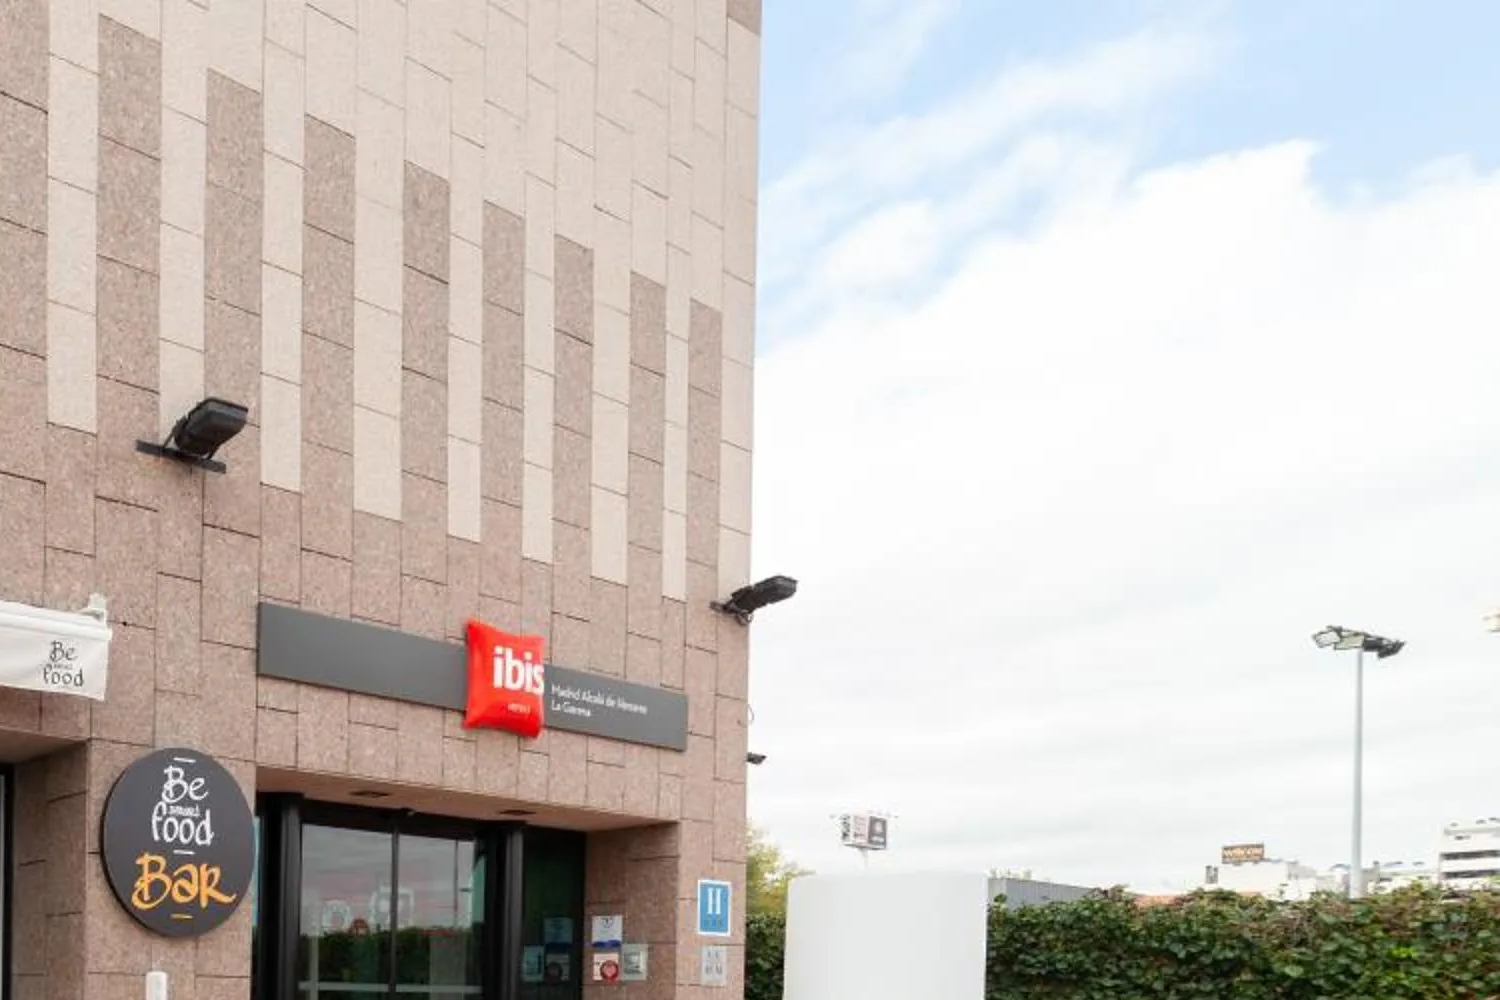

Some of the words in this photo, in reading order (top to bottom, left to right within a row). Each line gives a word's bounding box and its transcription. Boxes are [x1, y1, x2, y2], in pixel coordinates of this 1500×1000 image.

[50, 640, 78, 662] Be
[43, 663, 84, 687] food
[493, 645, 544, 696] ibis
[161, 765, 209, 803] Be
[151, 801, 215, 847] food
